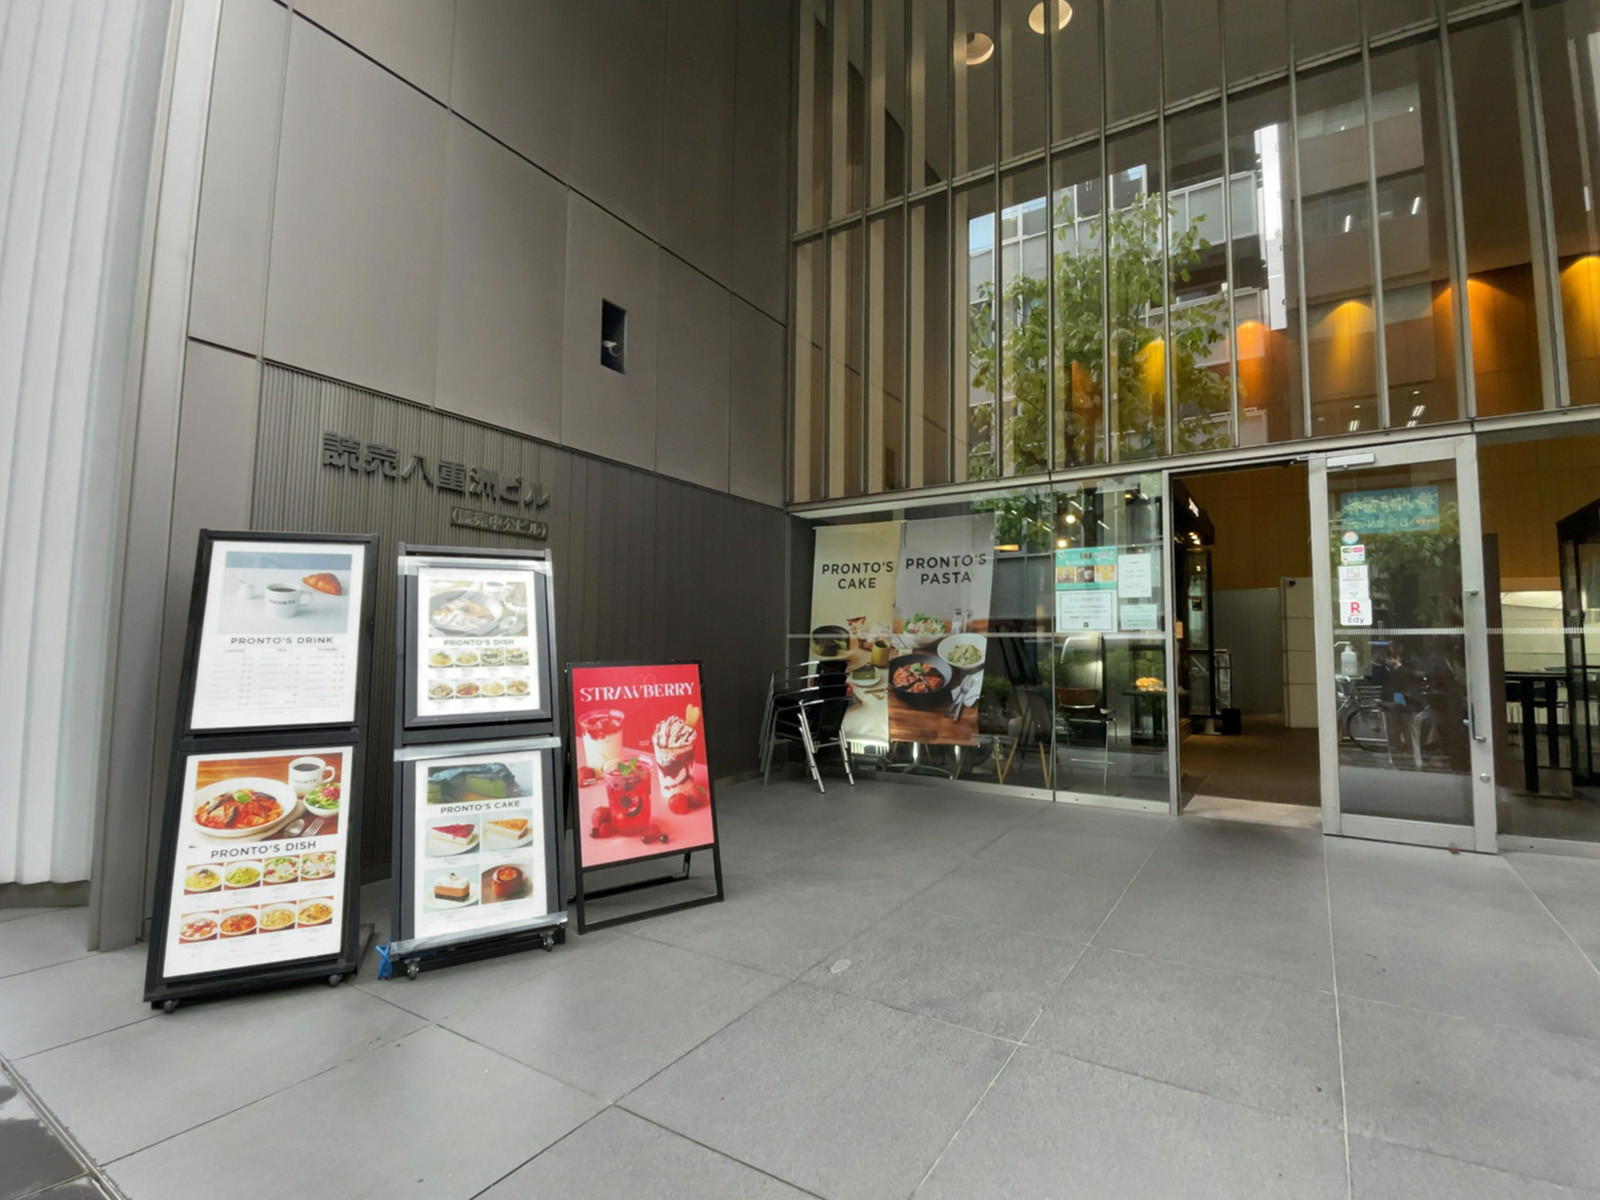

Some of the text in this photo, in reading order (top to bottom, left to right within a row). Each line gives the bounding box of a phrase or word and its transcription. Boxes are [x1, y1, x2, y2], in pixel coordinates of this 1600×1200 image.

[821, 560, 894, 576] PRONTO'S
[905, 553, 988, 570] PRONTO'S
[837, 577, 877, 590] CAKE
[920, 571, 972, 585] PASTA
[1347, 616, 1365, 624] Edy
[230, 636, 334, 645] PRONTO'S DRINK
[579, 681, 695, 702] STRAWBERRY
[440, 800, 521, 814] PRONTO'S CAKE
[210, 845, 280, 859] PRONTO'S
[285, 840, 317, 851] DISH
